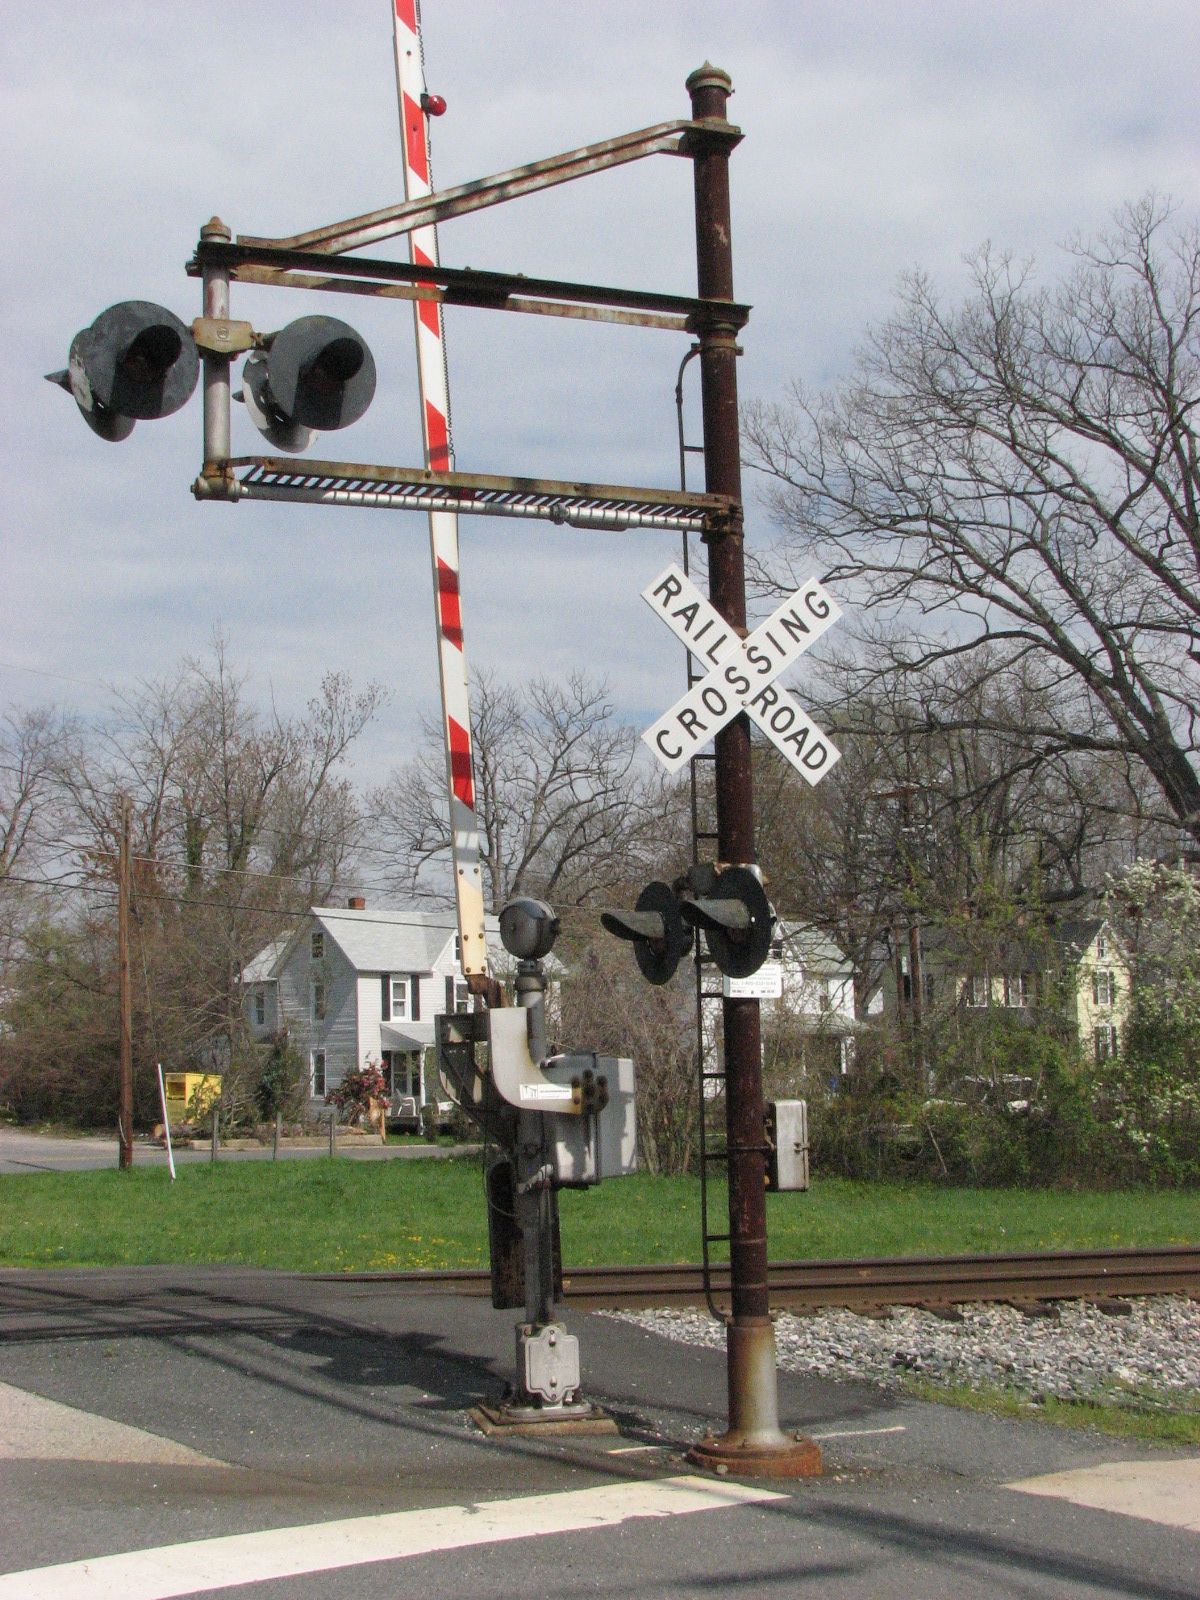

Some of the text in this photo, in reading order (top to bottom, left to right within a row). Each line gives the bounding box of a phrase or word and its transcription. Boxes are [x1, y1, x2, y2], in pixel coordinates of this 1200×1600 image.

[653, 574, 828, 770] RAIL ROAD
[656, 591, 830, 760] CROSSING
